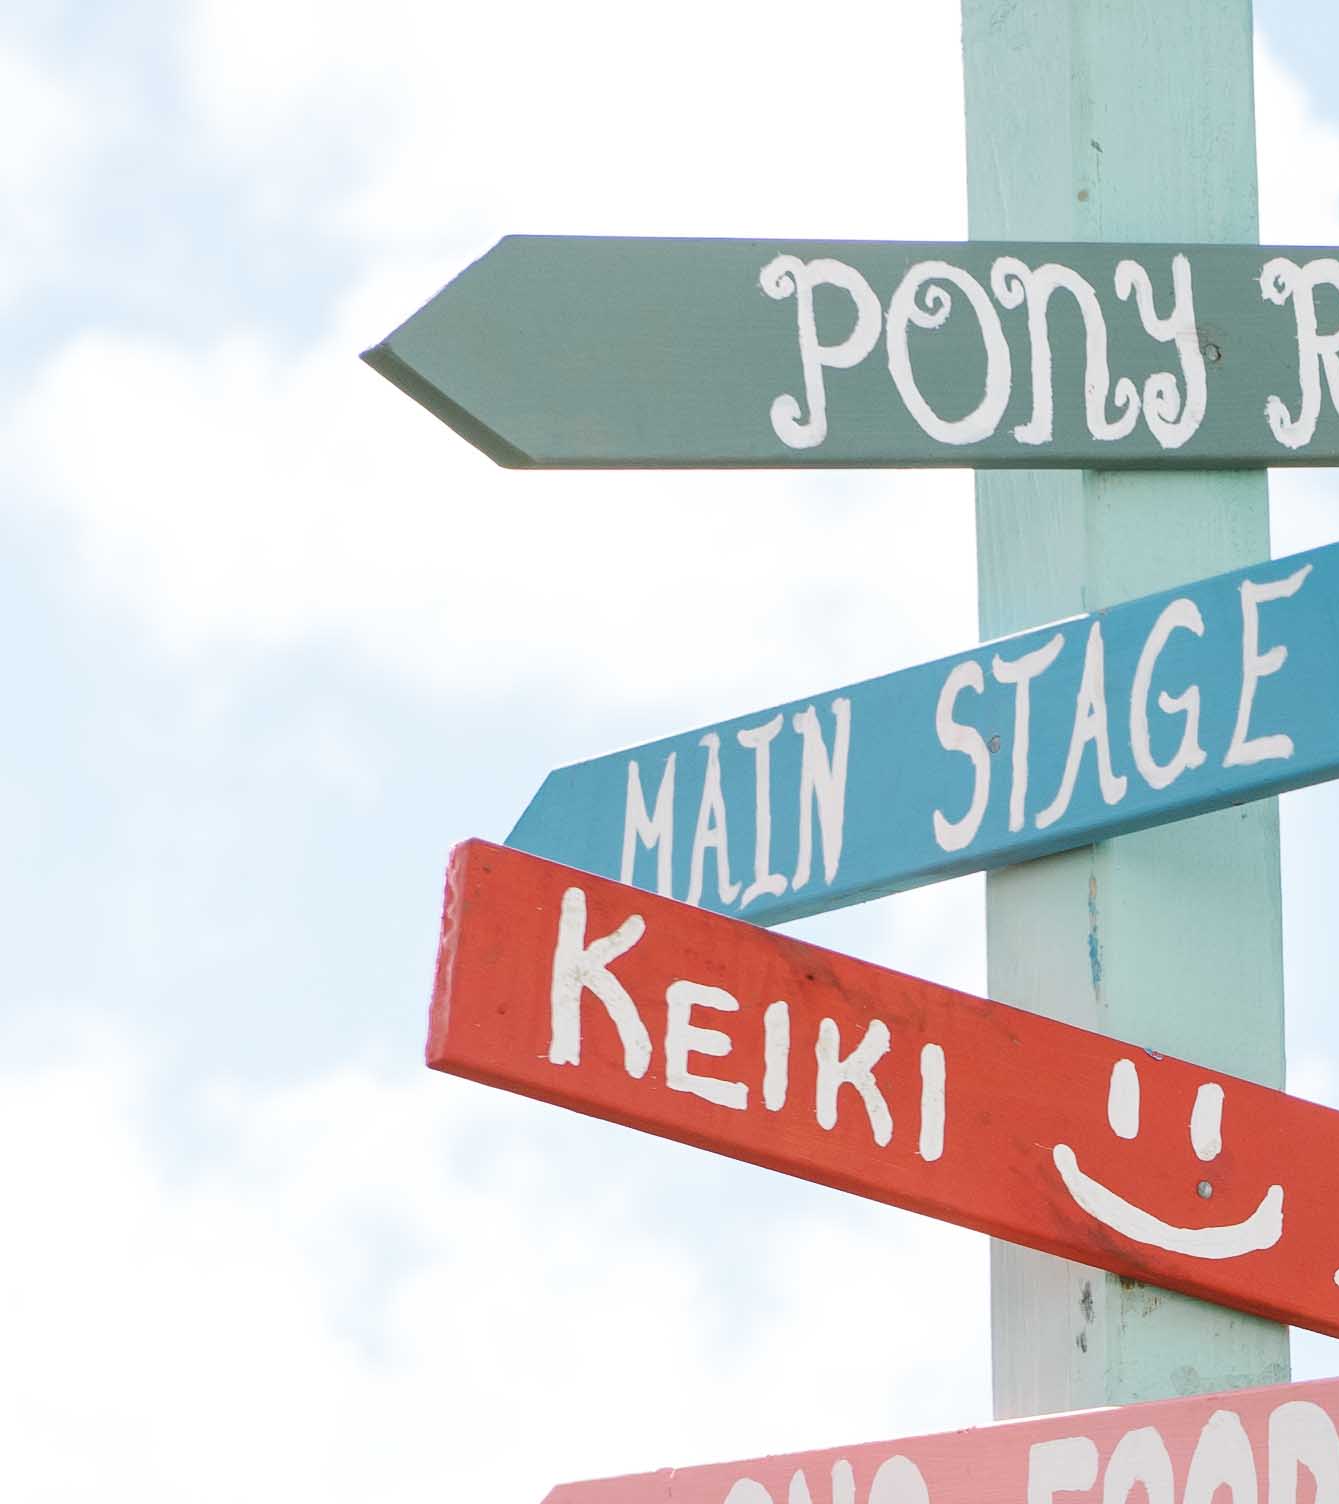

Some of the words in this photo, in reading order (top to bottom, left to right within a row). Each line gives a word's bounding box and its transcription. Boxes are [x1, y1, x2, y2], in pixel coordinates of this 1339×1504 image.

[760, 253, 1204, 449] PONY
[620, 697, 850, 910] MAIN
[932, 564, 1315, 851] STAGE
[548, 887, 947, 1163] KEIKI
